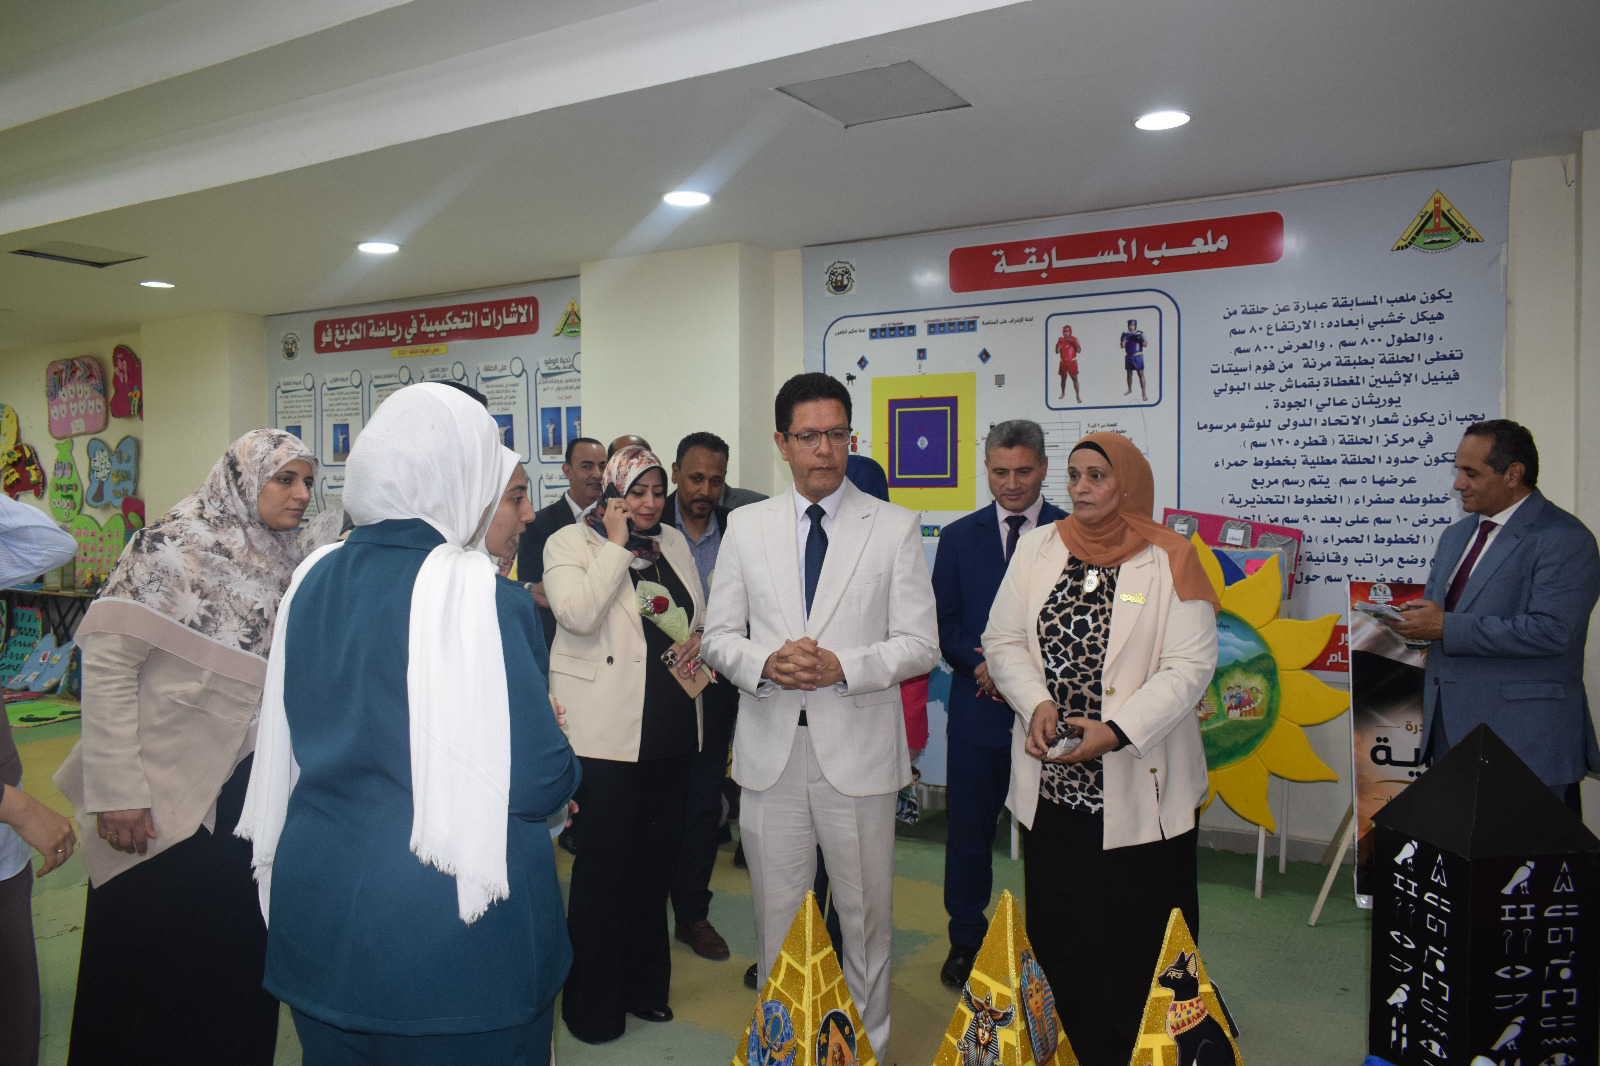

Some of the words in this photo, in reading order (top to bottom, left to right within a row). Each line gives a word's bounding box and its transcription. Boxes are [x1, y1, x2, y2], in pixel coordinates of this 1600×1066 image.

[1144, 229, 1229, 266] ملعب
[992, 238, 1137, 278] المسابقة
[1331, 294, 1383, 311] المسابقة
[1386, 292, 1416, 307] ملعب
[1420, 288, 1453, 304] يكون
[1241, 304, 1268, 315] حلقة
[1272, 303, 1291, 316] عن
[1293, 300, 1328, 313] عبارة
[480, 303, 533, 330] الاشارات
[1223, 308, 1237, 319] من
[1410, 310, 1445, 325] هيكل
[420, 311, 478, 338] التحكيمية
[1368, 312, 1406, 330] خشبي
[368, 319, 401, 342] رياضة
[405, 316, 417, 343] في
[1229, 328, 1246, 338] سم
[1250, 326, 1263, 334] ٨٠
[1266, 320, 1316, 336] الارتفاع
[320, 324, 332, 347] فو
[334, 322, 366, 348] الكونغ
[1361, 337, 1382, 346] ٨٠٠
[1386, 332, 1434, 347] والطول
[1254, 344, 1274, 352] ٨٠٠
[1278, 340, 1325, 354] والعرض
[1338, 340, 1356, 350] سم
[1302, 357, 1331, 370] مرنة
[1334, 355, 1375, 369] بطبقة
[1378, 352, 1420, 365] الحلقة
[1424, 349, 1463, 365] تغطى
[1210, 361, 1252, 375] أسيتات
[1255, 360, 1275, 374] فوم
[1278, 361, 1293, 373] من
[1324, 375, 1365, 388] المغطاة
[1368, 370, 1418, 388] الإثيلين
[1421, 369, 1460, 385] فينيل
[1214, 382, 1251, 397] البولي
[1254, 380, 1276, 393] جلد
[1279, 377, 1320, 392] بقماش
[1273, 398, 1312, 411] الجودة
[1316, 397, 1348, 412] عالي
[1352, 392, 1402, 408] يوريثان
[1278, 418, 1317, 430] الدولى
[1321, 415, 1366, 427] الاتحاد
[1369, 412, 1399, 427] شعار
[1402, 412, 1435, 426] يكون
[1438, 410, 1452, 425] أن
[1197, 420, 1236, 432] مرسوما
[1240, 418, 1271, 431] للوشو
[1271, 438, 1289, 446] ١٢٠
[1338, 434, 1379, 445] الحلقة
[1382, 433, 1414, 447] مركز
[1418, 431, 1433, 448] في
[1214, 458, 1248, 469] حمراء
[1253, 456, 1297, 469] بخطوط
[1301, 455, 1338, 468] مطلية
[1340, 454, 1381, 465] الحلقة
[1386, 455, 1419, 467] حدود
[1251, 478, 1279, 489] مربع
[1282, 478, 1305, 488] رسم
[1308, 475, 1330, 488] يتم
[1372, 474, 1417, 487] عرضها
[1354, 494, 1395, 507] صفراء
[1399, 493, 1451, 507] خطوطه
[1282, 517, 1299, 525] سم
[1303, 514, 1316, 523] ٩٠
[1320, 515, 1342, 527] بعد
[1345, 514, 1369, 527] على
[1374, 517, 1392, 527] سم
[1396, 515, 1408, 523] ١٠
[1354, 553, 1394, 567] مراتب
[1397, 554, 1426, 568] وضع
[1295, 572, 1321, 584] حول
